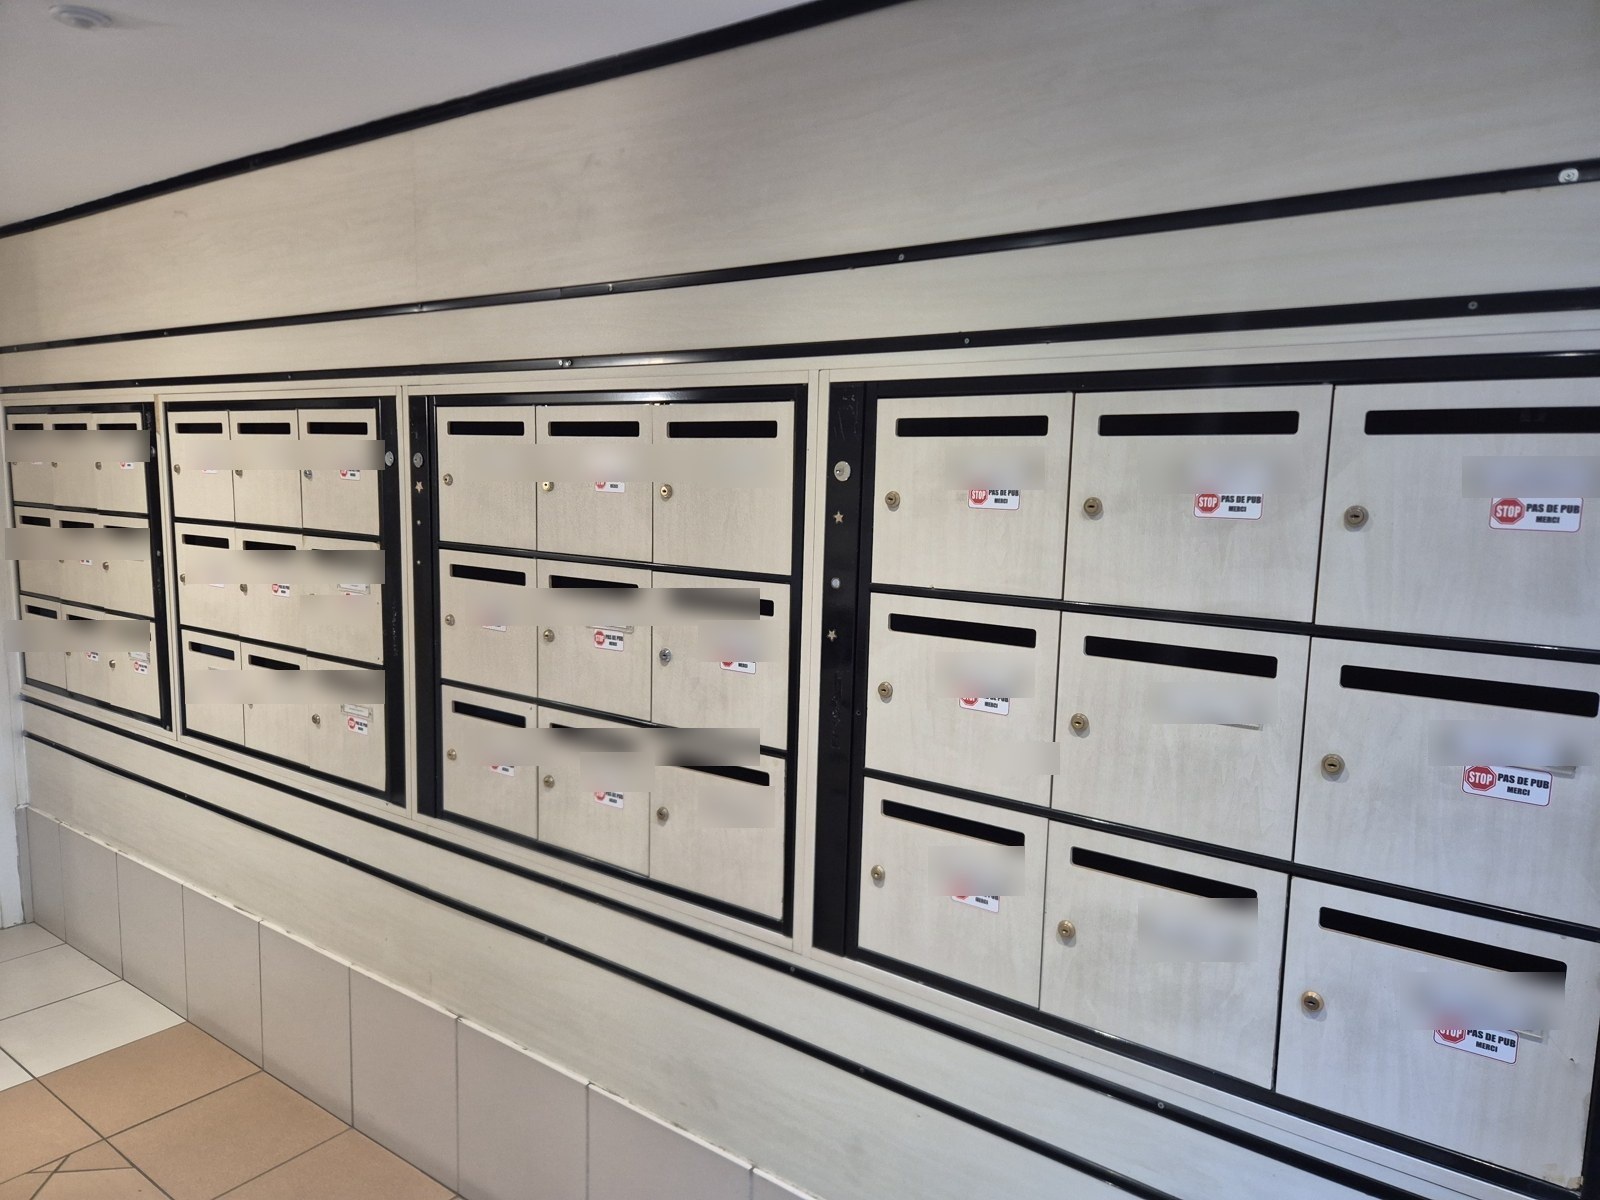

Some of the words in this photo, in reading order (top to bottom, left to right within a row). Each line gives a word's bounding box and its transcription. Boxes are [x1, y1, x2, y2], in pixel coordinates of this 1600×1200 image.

[971, 490, 986, 500] STOP
[1198, 496, 1218, 508] STOP
[1221, 495, 1235, 503] PAS
[1236, 495, 1245, 504] DE
[1246, 496, 1262, 504] PUB
[1496, 505, 1521, 518] STOP
[1526, 503, 1544, 513] PAS
[1546, 504, 1559, 513] DE
[1560, 504, 1580, 514] PUB
[1535, 515, 1560, 523] MERCI
[1469, 771, 1493, 785] STOP
[1497, 773, 1515, 784] PAS
[1516, 776, 1529, 787] DE
[1530, 778, 1549, 789] PUB
[1506, 786, 1530, 796] MERCI
[1467, 1030, 1484, 1039] PAS
[1485, 1032, 1497, 1043] DE
[1498, 1036, 1516, 1048] PUB
[1475, 1041, 1498, 1053] MERCI
